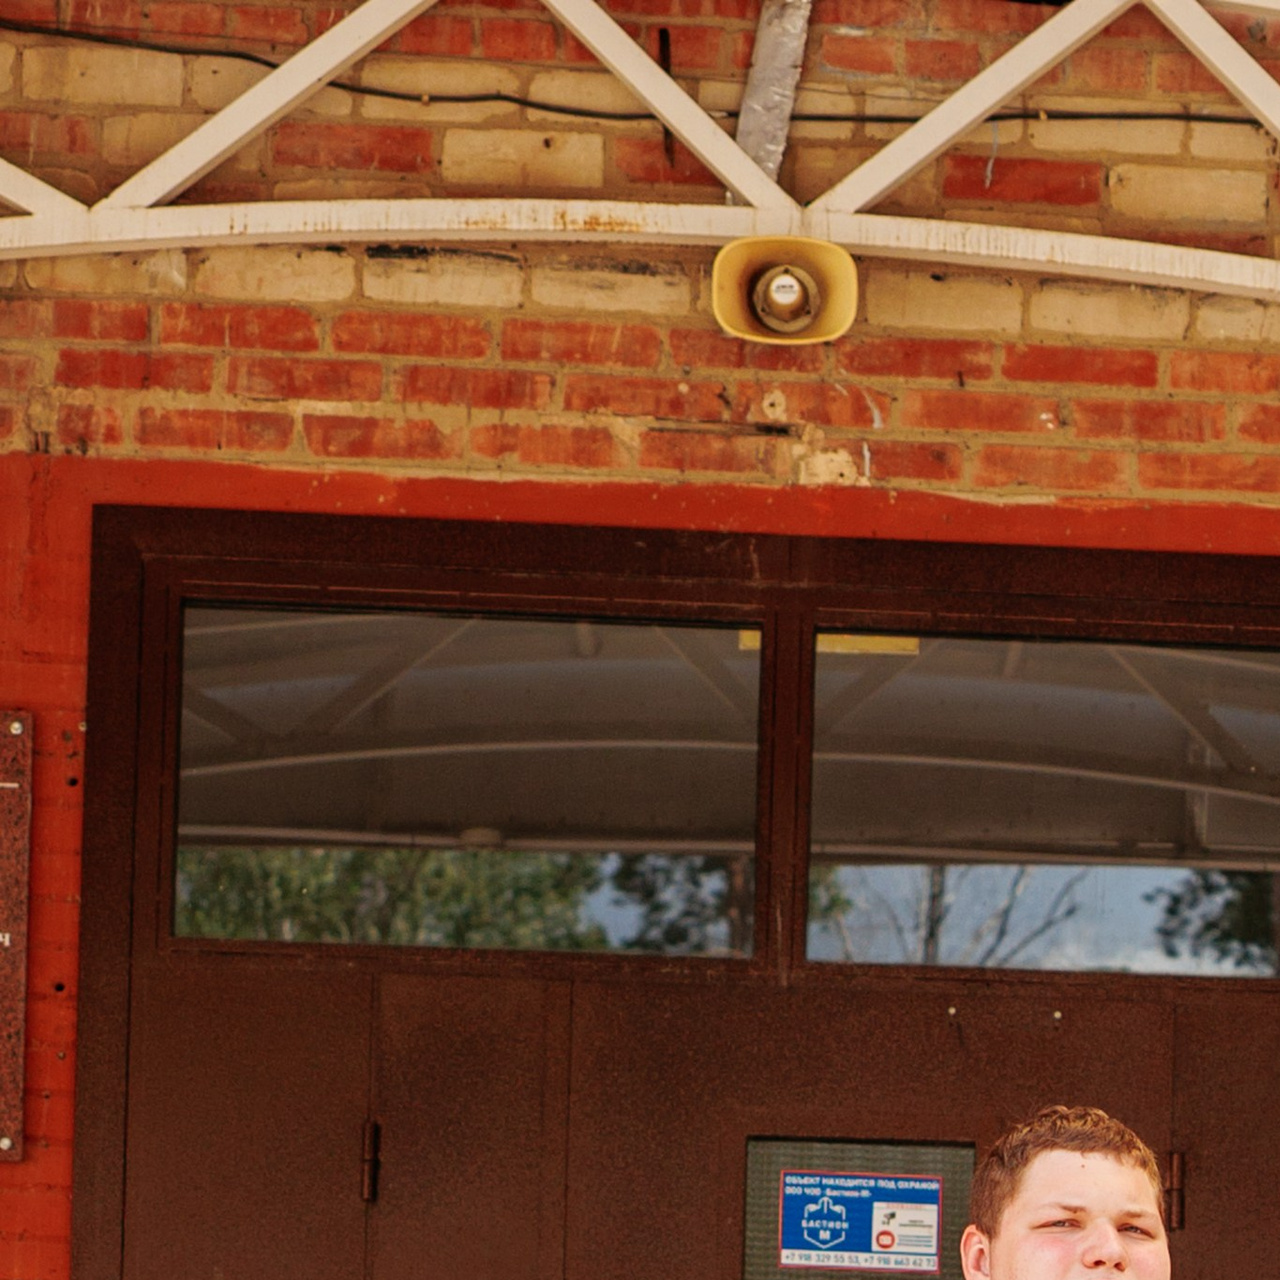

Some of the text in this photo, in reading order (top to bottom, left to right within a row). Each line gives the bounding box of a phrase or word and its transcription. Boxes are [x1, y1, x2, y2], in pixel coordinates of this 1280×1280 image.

[785, 1176, 820, 1185] ОБЪЕКТ
[822, 1177, 875, 1188] НАХОДИТСЯ
[898, 1181, 939, 1190] ОХРАНОЙ
[801, 1221, 849, 1229] БАСТИОН
